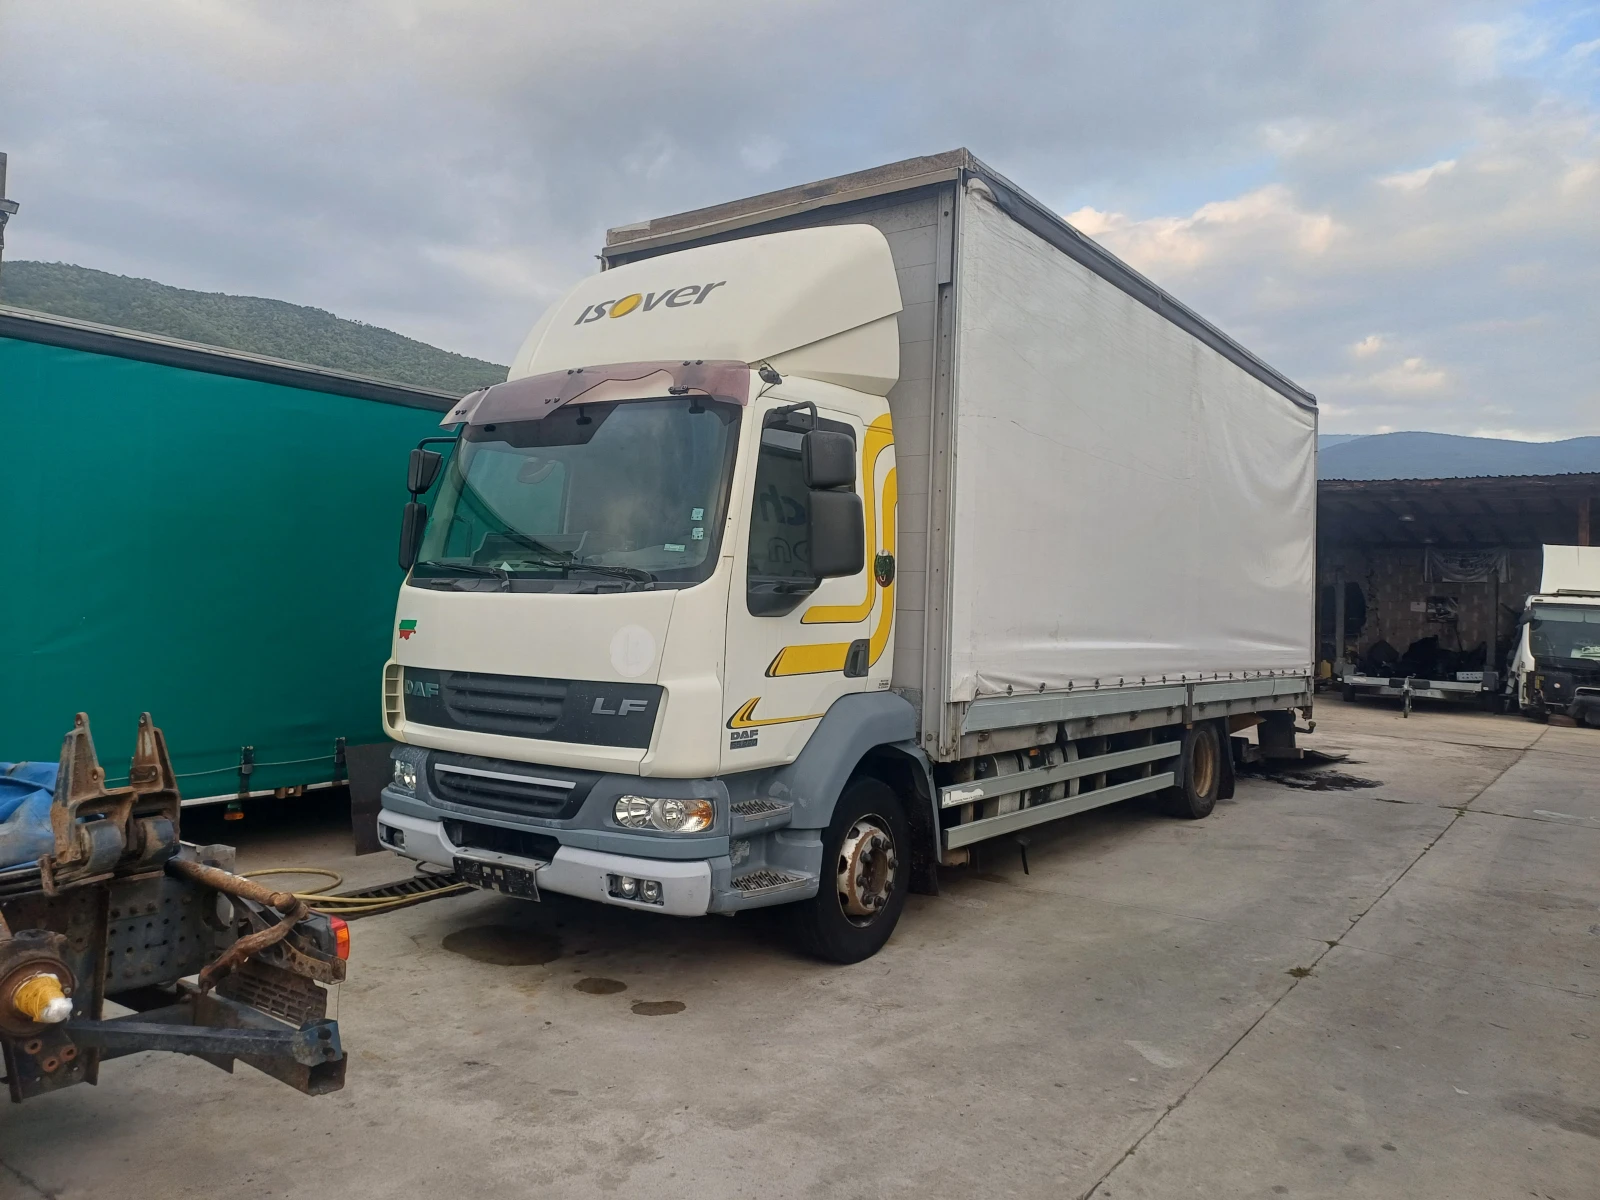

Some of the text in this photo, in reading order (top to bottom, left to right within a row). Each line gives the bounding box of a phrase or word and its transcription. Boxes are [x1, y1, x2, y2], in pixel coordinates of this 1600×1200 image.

[405, 679, 439, 698] DAF
[591, 697, 649, 716] LF
[730, 729, 759, 741] DAF
